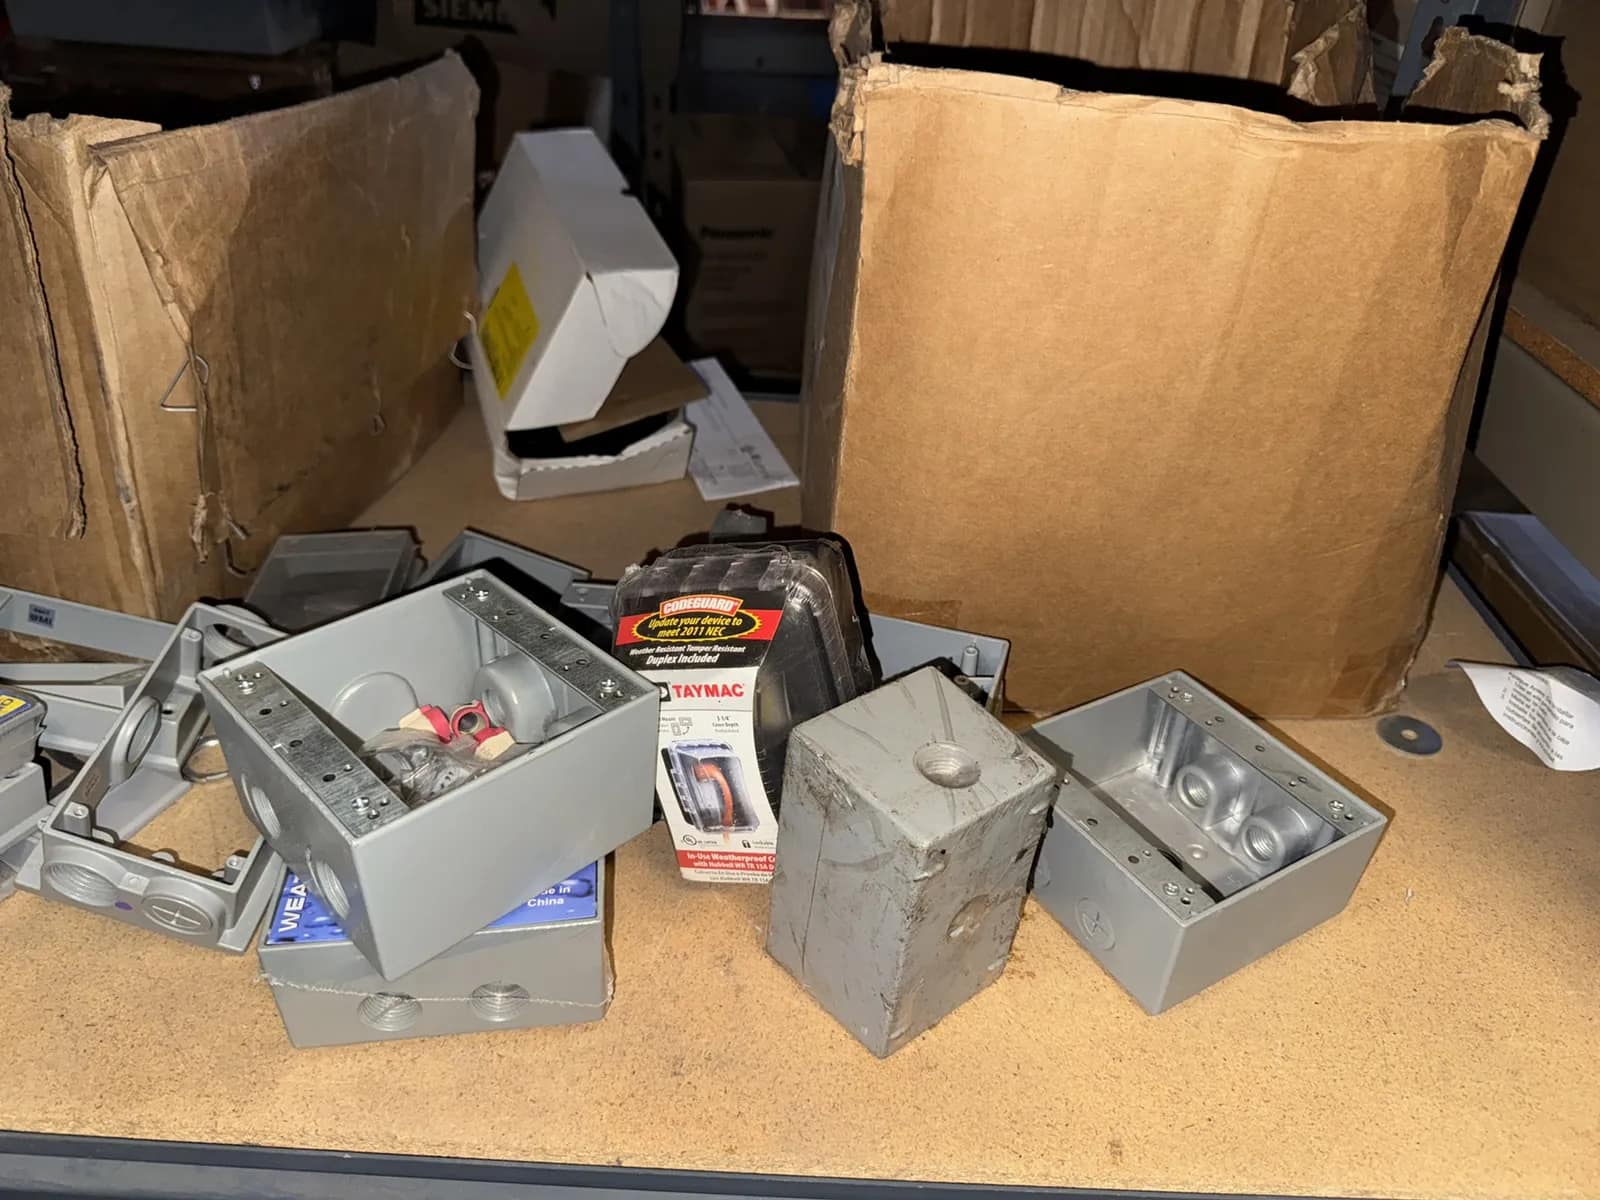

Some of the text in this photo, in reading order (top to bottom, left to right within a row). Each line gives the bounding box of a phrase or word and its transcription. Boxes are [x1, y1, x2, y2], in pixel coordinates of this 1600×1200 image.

[422, 0, 512, 25] SIEM
[663, 598, 735, 614] CODEGUARD
[648, 615, 743, 629] Update your device to
[657, 626, 726, 638] meet 2011 NEC
[630, 645, 746, 656] Weather Resistant Tamper Resistant
[646, 653, 720, 667] Duplex Included
[671, 683, 744, 698] TAYMAC
[687, 852, 710, 860] In-Use
[710, 853, 767, 863] Weatherproof
[559, 885, 571, 894] in
[278, 876, 307, 933] WEA
[527, 897, 565, 907] China
